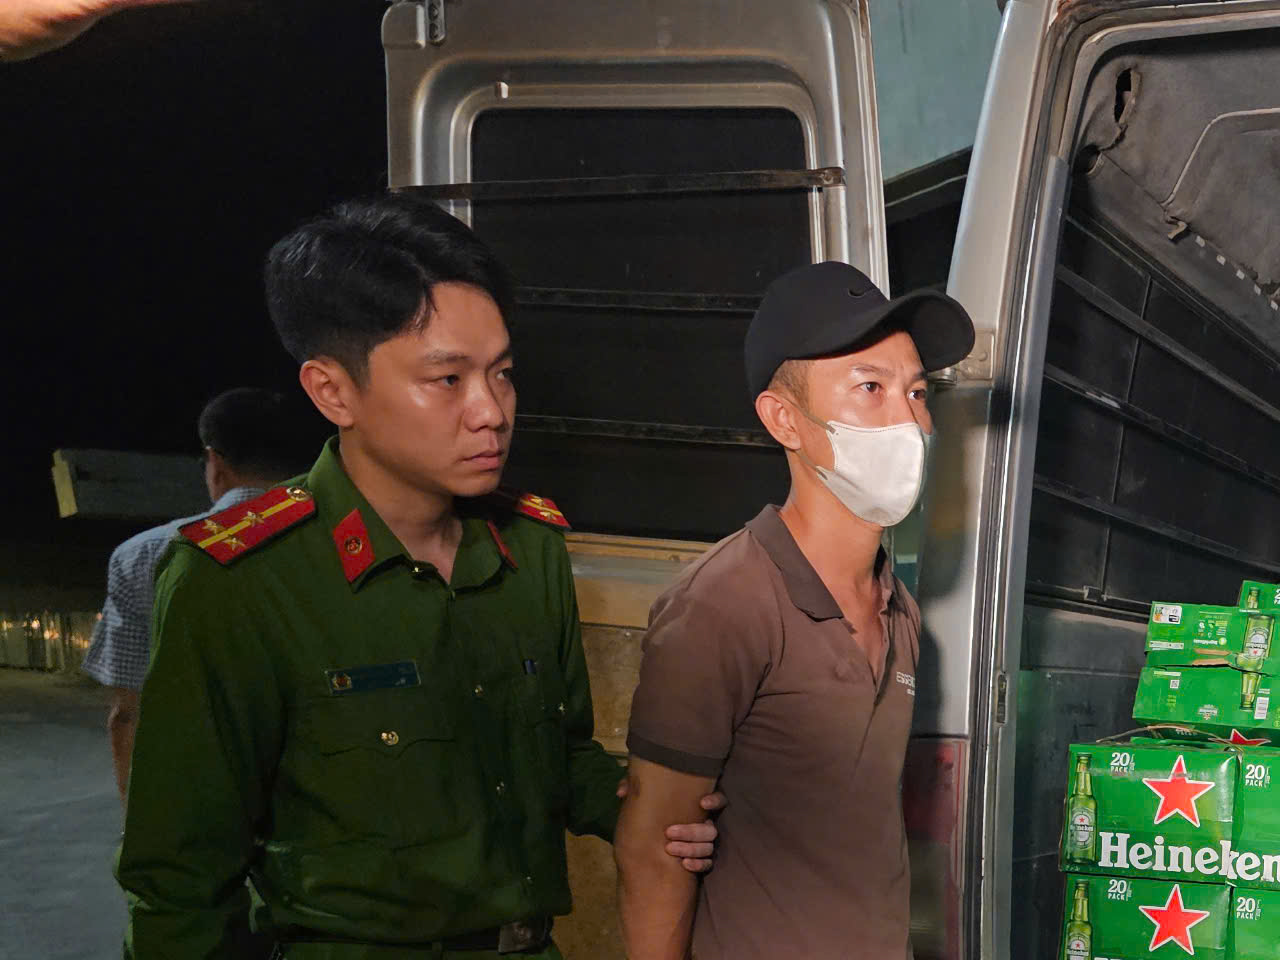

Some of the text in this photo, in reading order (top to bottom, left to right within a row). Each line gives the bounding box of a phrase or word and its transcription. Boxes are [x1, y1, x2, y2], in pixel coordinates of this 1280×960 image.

[1110, 752, 1130, 767] 20
[1245, 765, 1265, 779] 20
[1245, 779, 1264, 787] PACK
[1108, 880, 1127, 893] 20
[1237, 897, 1256, 912] 20
[1236, 912, 1255, 920] PACK
